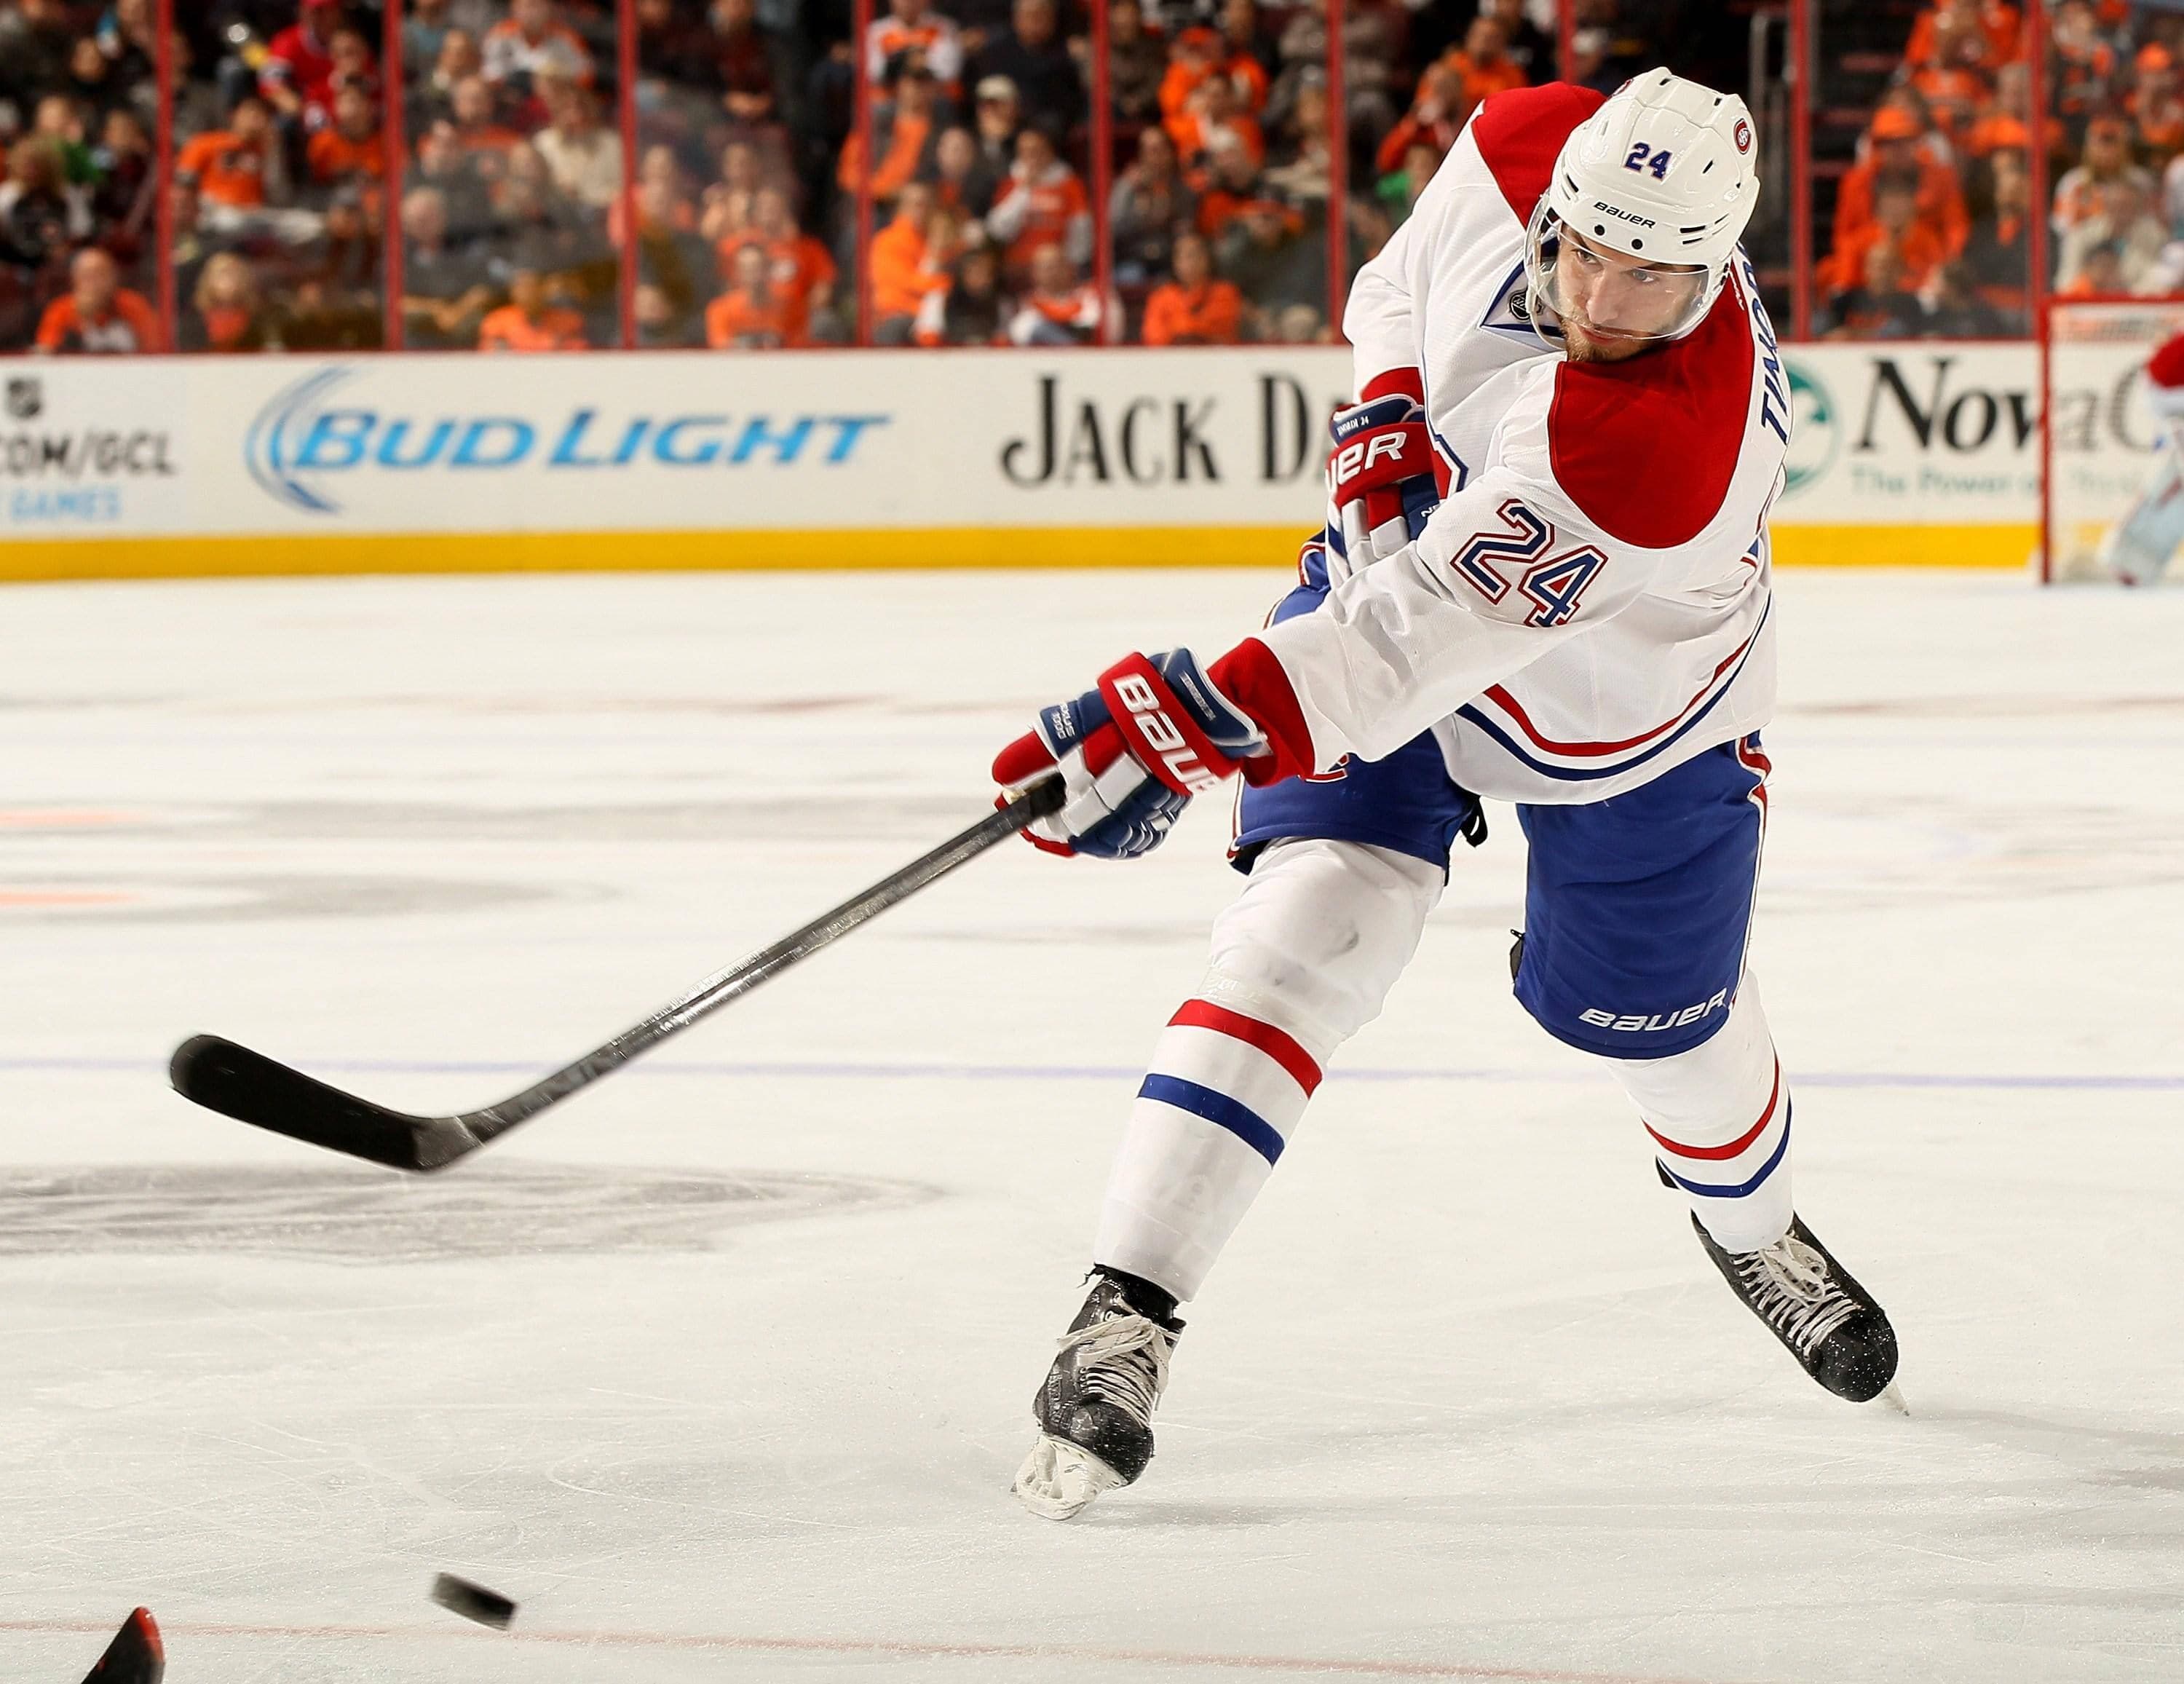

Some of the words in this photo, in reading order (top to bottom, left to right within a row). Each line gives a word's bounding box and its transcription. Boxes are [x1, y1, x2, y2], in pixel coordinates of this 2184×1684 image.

[1623, 141, 1673, 181] 24
[1593, 201, 1656, 229] BAUER
[293, 410, 537, 470] BUD
[546, 406, 893, 468] LIGHT
[999, 373, 1220, 488] JACK
[1360, 416, 1369, 426] 24
[0, 430, 177, 478] OM/GCL
[1449, 498, 1609, 628] 24
[1578, 987, 1728, 1032] BAUER
